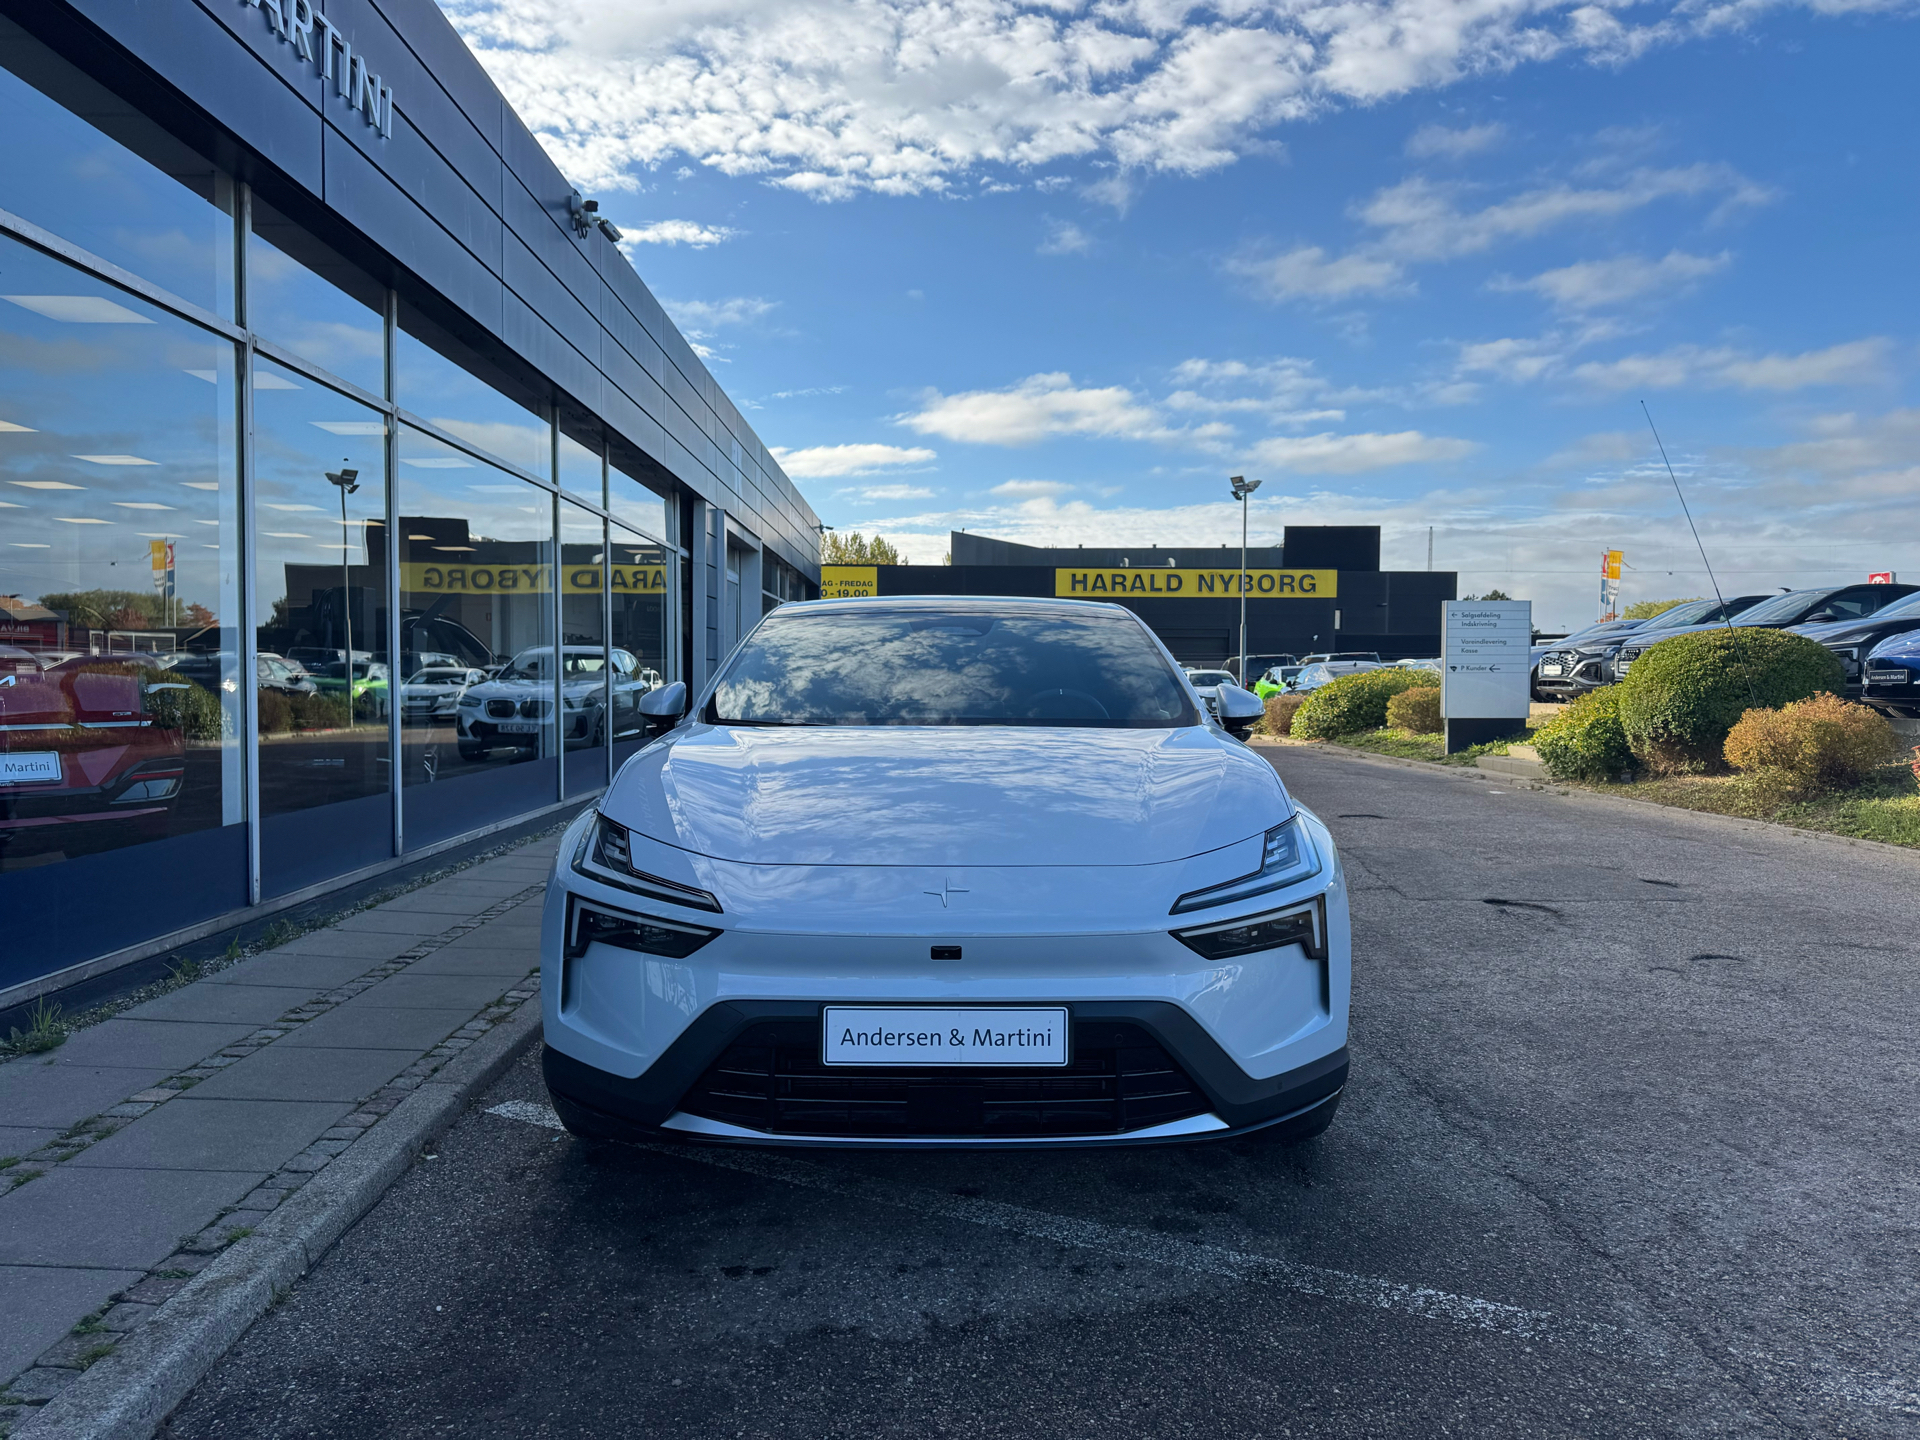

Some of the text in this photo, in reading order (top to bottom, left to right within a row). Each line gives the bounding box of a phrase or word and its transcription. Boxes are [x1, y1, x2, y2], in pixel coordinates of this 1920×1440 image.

[1070, 573, 1317, 593] HARALD NYBORG
[837, 589, 869, 597] 19.00
[1461, 620, 1497, 628] Indskrivning
[5, 761, 50, 773] Martini
[840, 1027, 1052, 1047] Andersen & Martini
